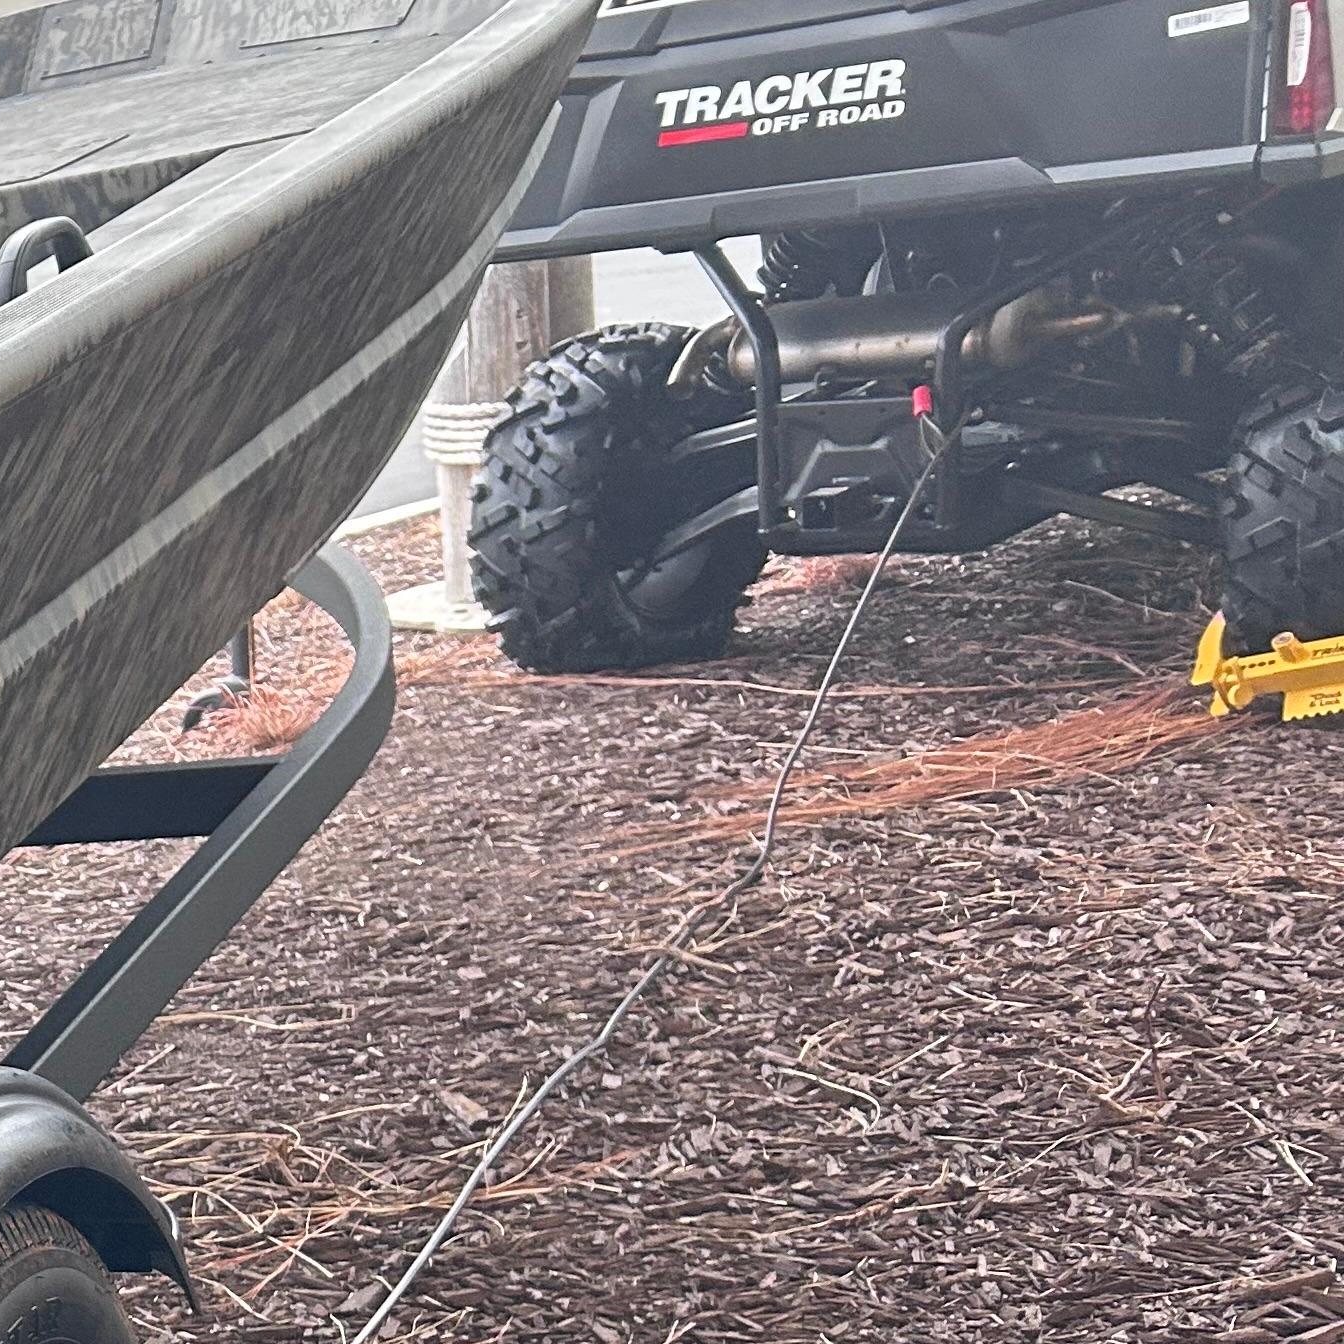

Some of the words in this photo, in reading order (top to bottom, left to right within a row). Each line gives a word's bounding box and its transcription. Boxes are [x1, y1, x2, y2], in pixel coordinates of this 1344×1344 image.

[655, 58, 906, 127] TRACKER
[752, 112, 810, 136] OFF
[816, 100, 906, 128] ROAD
